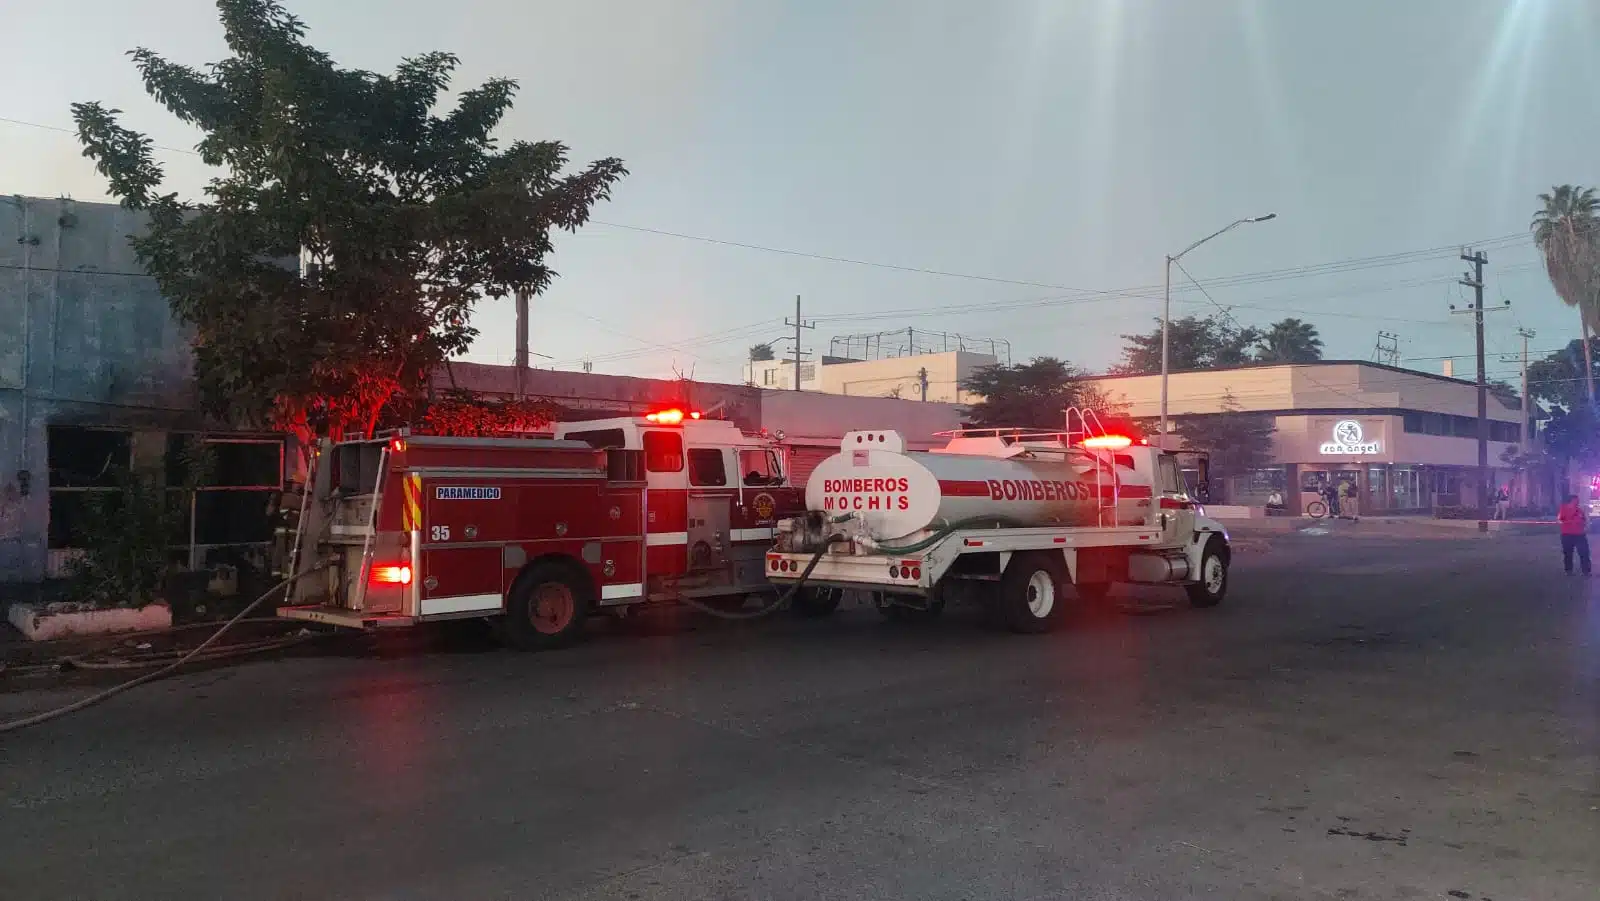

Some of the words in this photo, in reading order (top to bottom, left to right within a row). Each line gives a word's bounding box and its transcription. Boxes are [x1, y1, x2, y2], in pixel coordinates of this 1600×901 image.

[1347, 443, 1377, 456] angel
[824, 477, 909, 493] BOMBEROS
[987, 479, 1090, 501] BOMBEROS
[437, 487, 500, 499] PARAMEDICO
[824, 495, 909, 510] MOCHIS
[431, 525, 450, 541] 35
